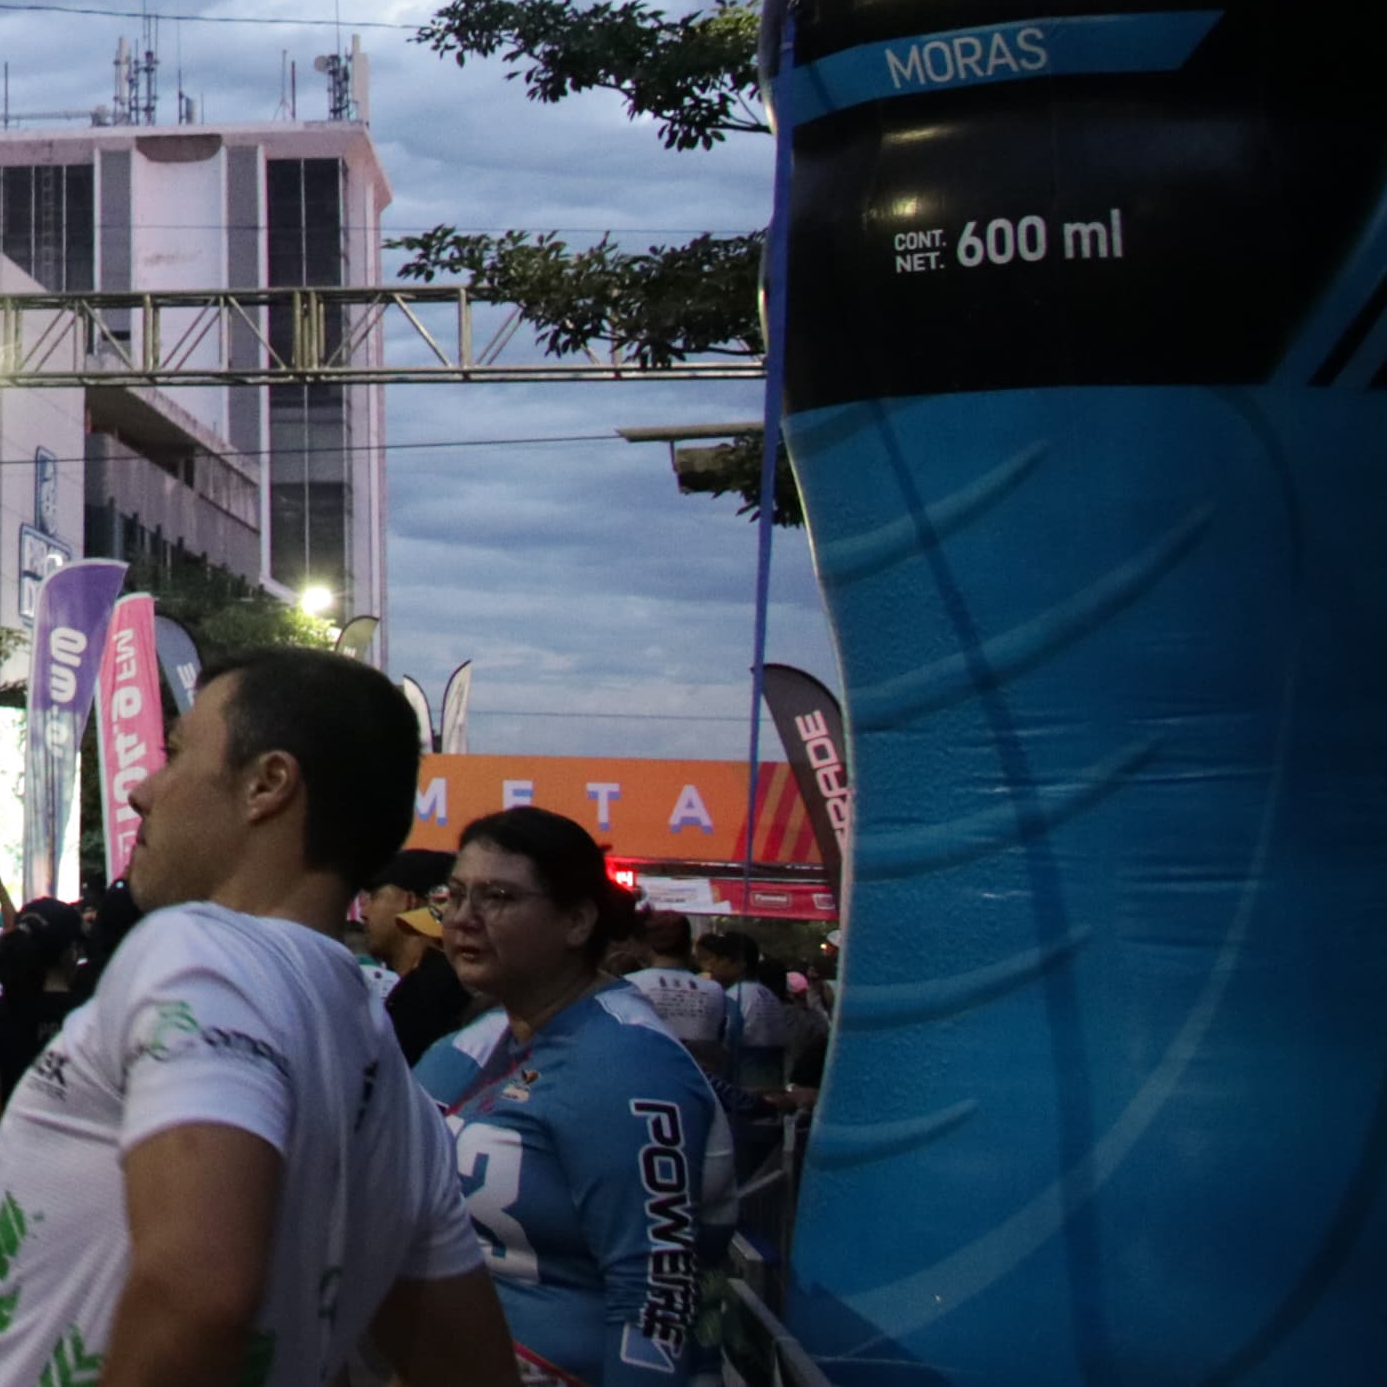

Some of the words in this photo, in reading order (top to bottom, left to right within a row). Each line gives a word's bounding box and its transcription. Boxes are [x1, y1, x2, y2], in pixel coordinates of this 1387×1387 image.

[885, 27, 1049, 90] MORAS
[894, 229, 947, 251] CONT.
[956, 215, 1047, 267] 600
[1063, 208, 1123, 259] ml
[896, 251, 945, 273] NET.
